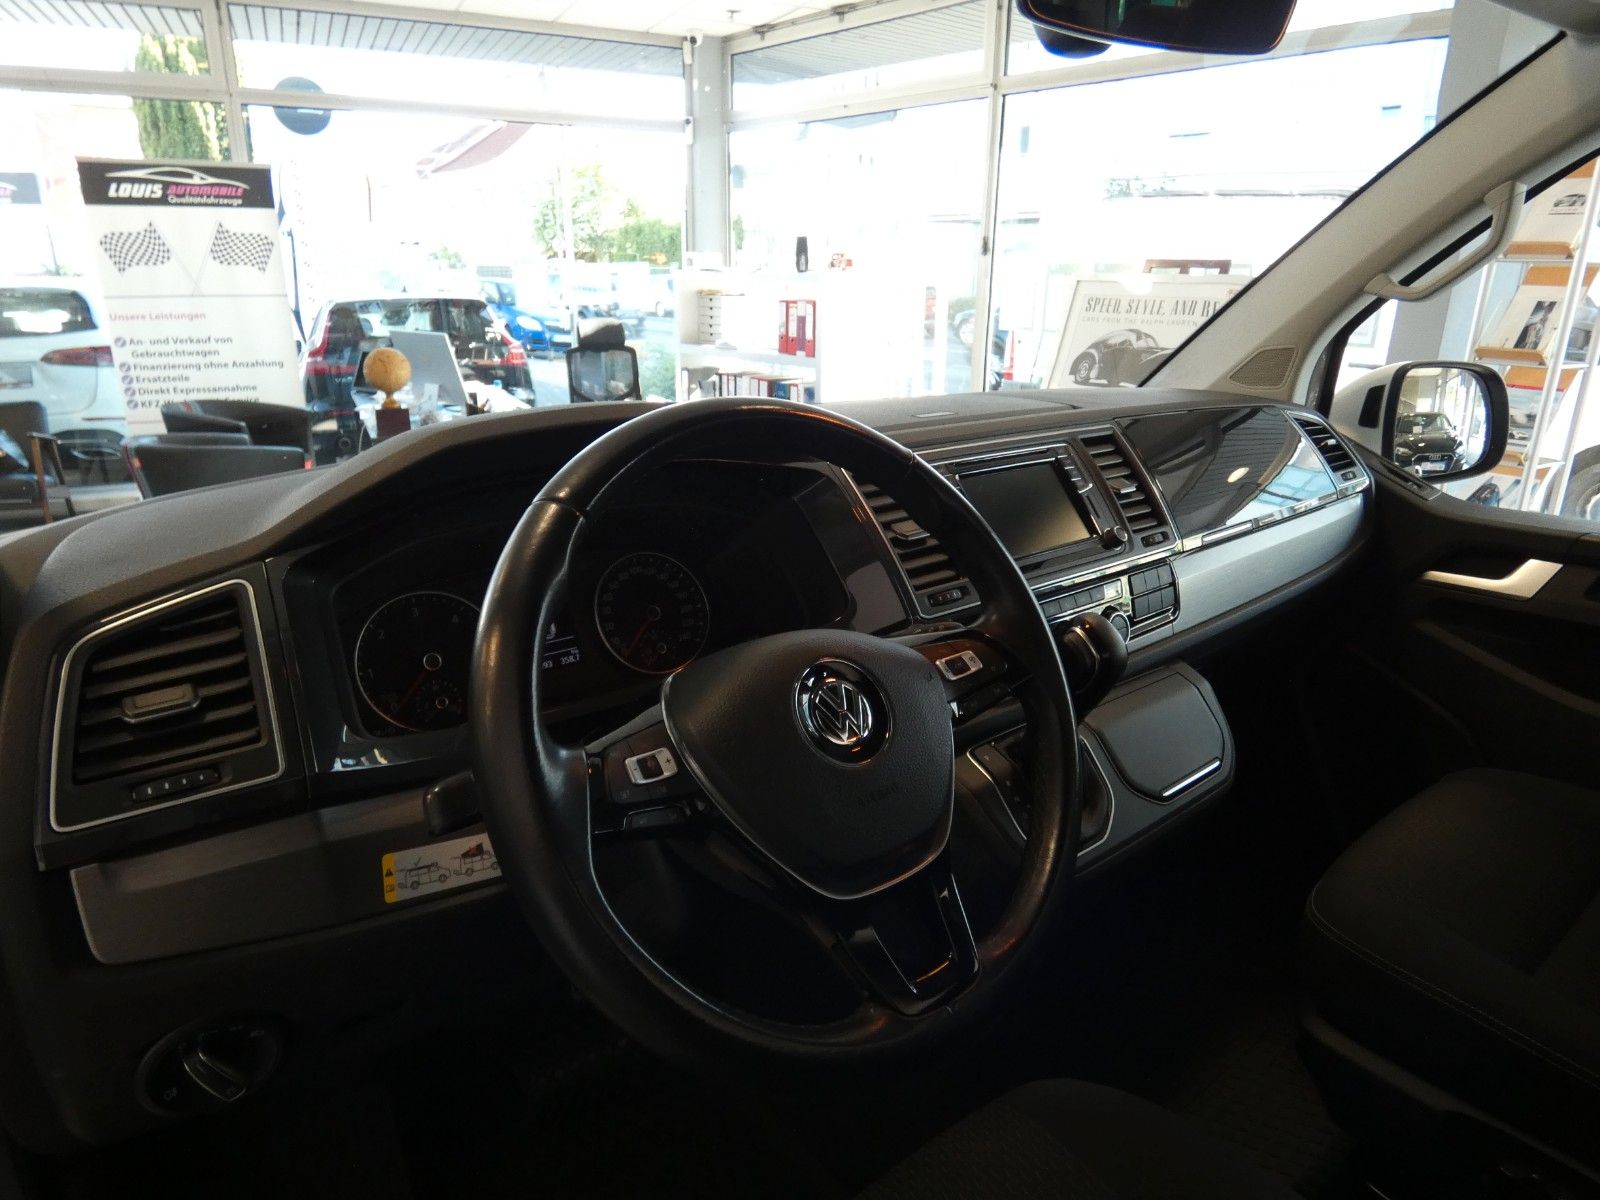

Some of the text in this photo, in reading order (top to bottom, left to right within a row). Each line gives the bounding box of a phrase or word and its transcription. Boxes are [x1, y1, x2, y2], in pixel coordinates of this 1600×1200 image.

[108, 182, 244, 198] LOUIS AUTOMOBILE
[1172, 300, 1198, 316] AND
[109, 311, 206, 323] Unsere Leistungen
[150, 336, 169, 345] und
[171, 335, 211, 345] Verkauf
[214, 336, 233, 344] von
[131, 349, 220, 359] Gebrauchtwagen
[133, 363, 201, 373] Finanzierung
[232, 360, 284, 369] Anzahlung
[136, 375, 190, 383] Ersatzteile
[138, 384, 257, 396] Direkt Expressannahme
